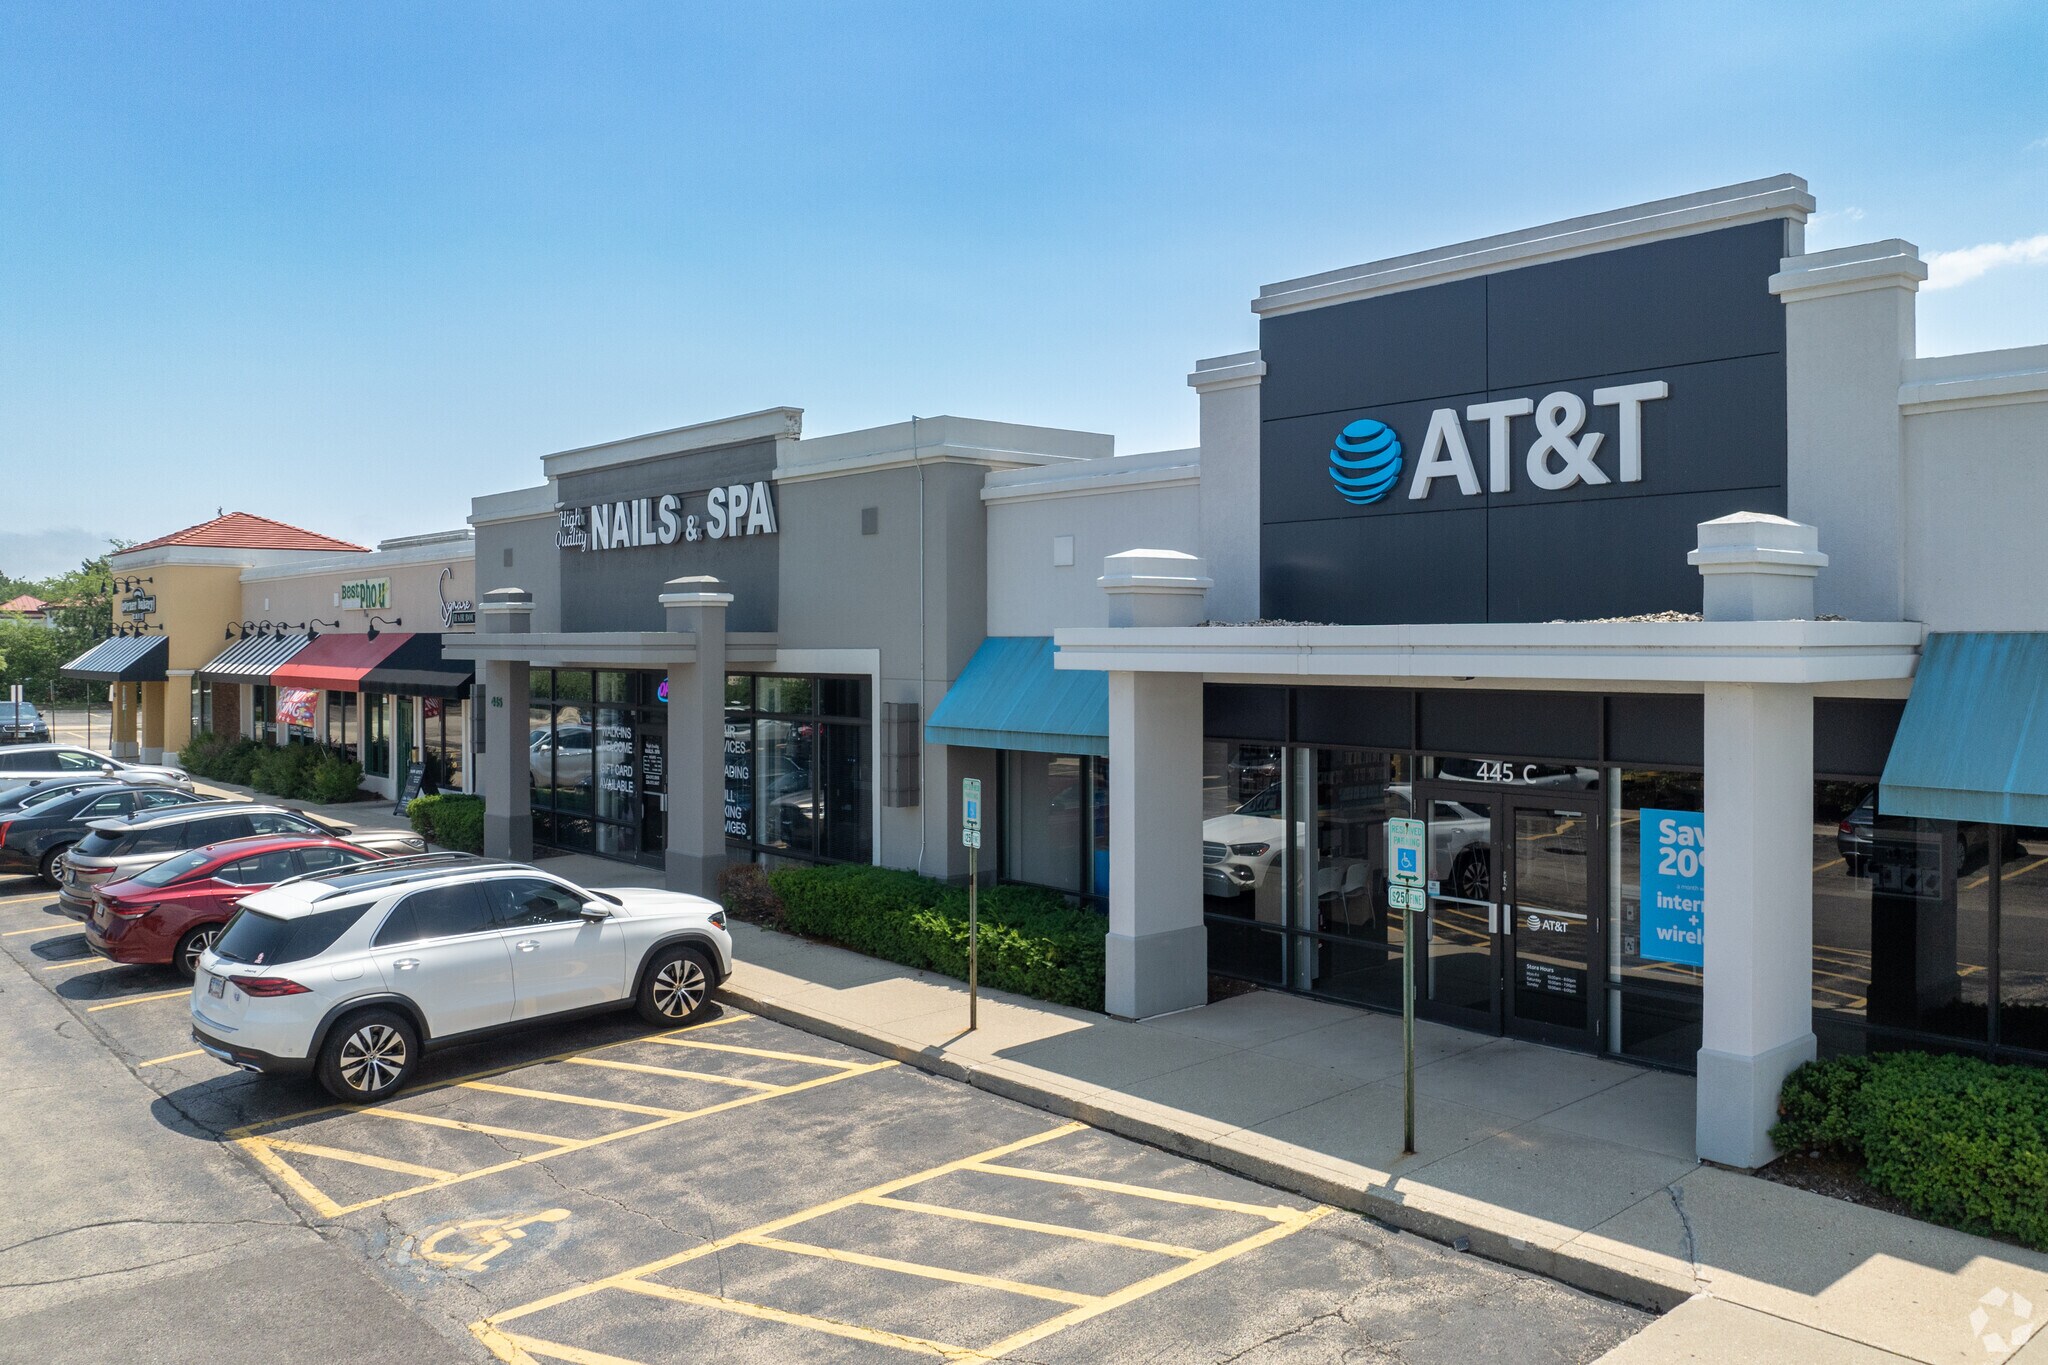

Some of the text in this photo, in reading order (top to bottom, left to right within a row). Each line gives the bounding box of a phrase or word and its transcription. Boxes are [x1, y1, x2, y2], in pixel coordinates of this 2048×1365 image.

[1408, 380, 1669, 500] AT&T
[558, 507, 585, 535] High
[591, 480, 778, 551] NAILS & SPA
[554, 528, 588, 553] Quality
[614, 764, 633, 778] CARD
[1476, 762, 1537, 785] 445 C
[599, 777, 634, 793] AVAILABLE
[1409, 893, 1422, 907] FINE
[1542, 919, 1569, 933] AT&T
[1656, 925, 1704, 945] wirel
[1526, 963, 1554, 973] Store Hours
